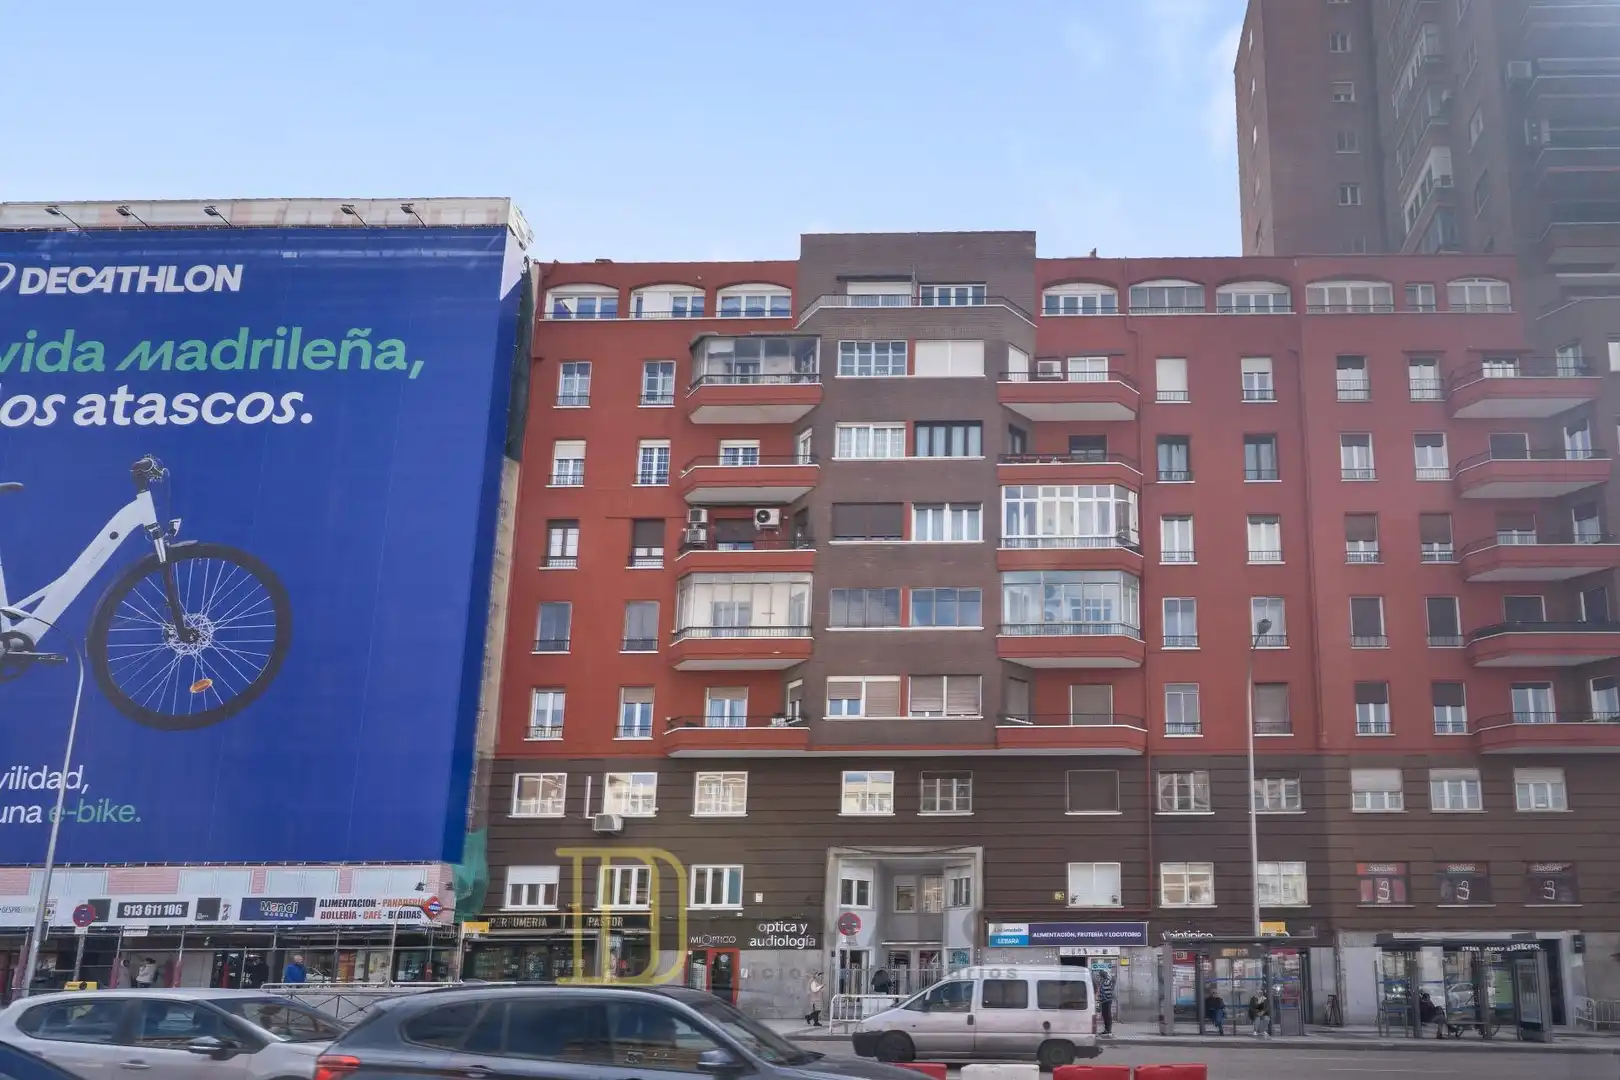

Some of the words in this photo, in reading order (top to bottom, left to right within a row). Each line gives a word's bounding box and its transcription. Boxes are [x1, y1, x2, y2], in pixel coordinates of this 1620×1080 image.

[19, 264, 243, 294] DECATHLON
[0, 383, 66, 427] os
[73, 384, 313, 427] atascos.
[48, 798, 141, 823] e-bike.
[123, 904, 143, 916] 913
[144, 904, 162, 916] 611
[163, 904, 183, 916] 106
[588, 917, 624, 927] PASTOR
[799, 923, 808, 934] y
[749, 934, 816, 949] audiología
[930, 951, 940, 969] 4
